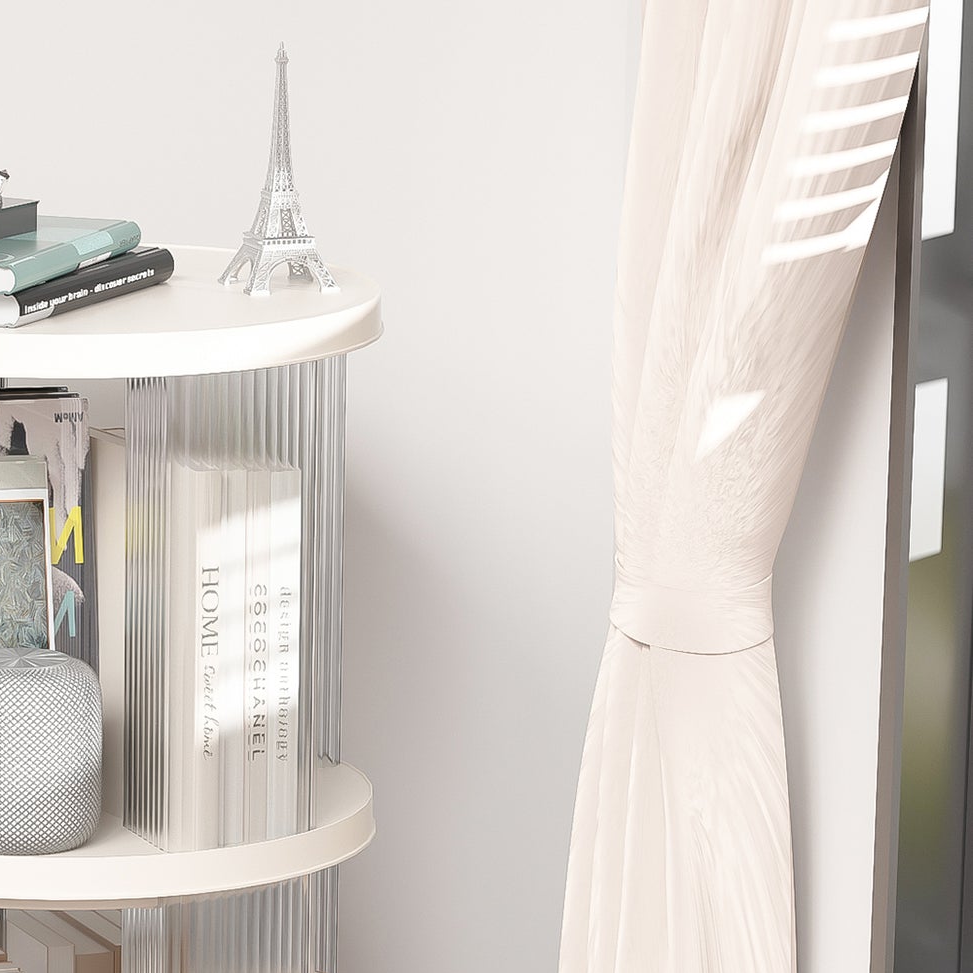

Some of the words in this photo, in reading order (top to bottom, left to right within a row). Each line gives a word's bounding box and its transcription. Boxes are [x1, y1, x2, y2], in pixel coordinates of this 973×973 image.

[49, 293, 68, 310] your
[67, 288, 90, 301] brain
[94, 276, 127, 293] discover
[127, 268, 155, 283] secrets
[201, 566, 220, 658] HOME
